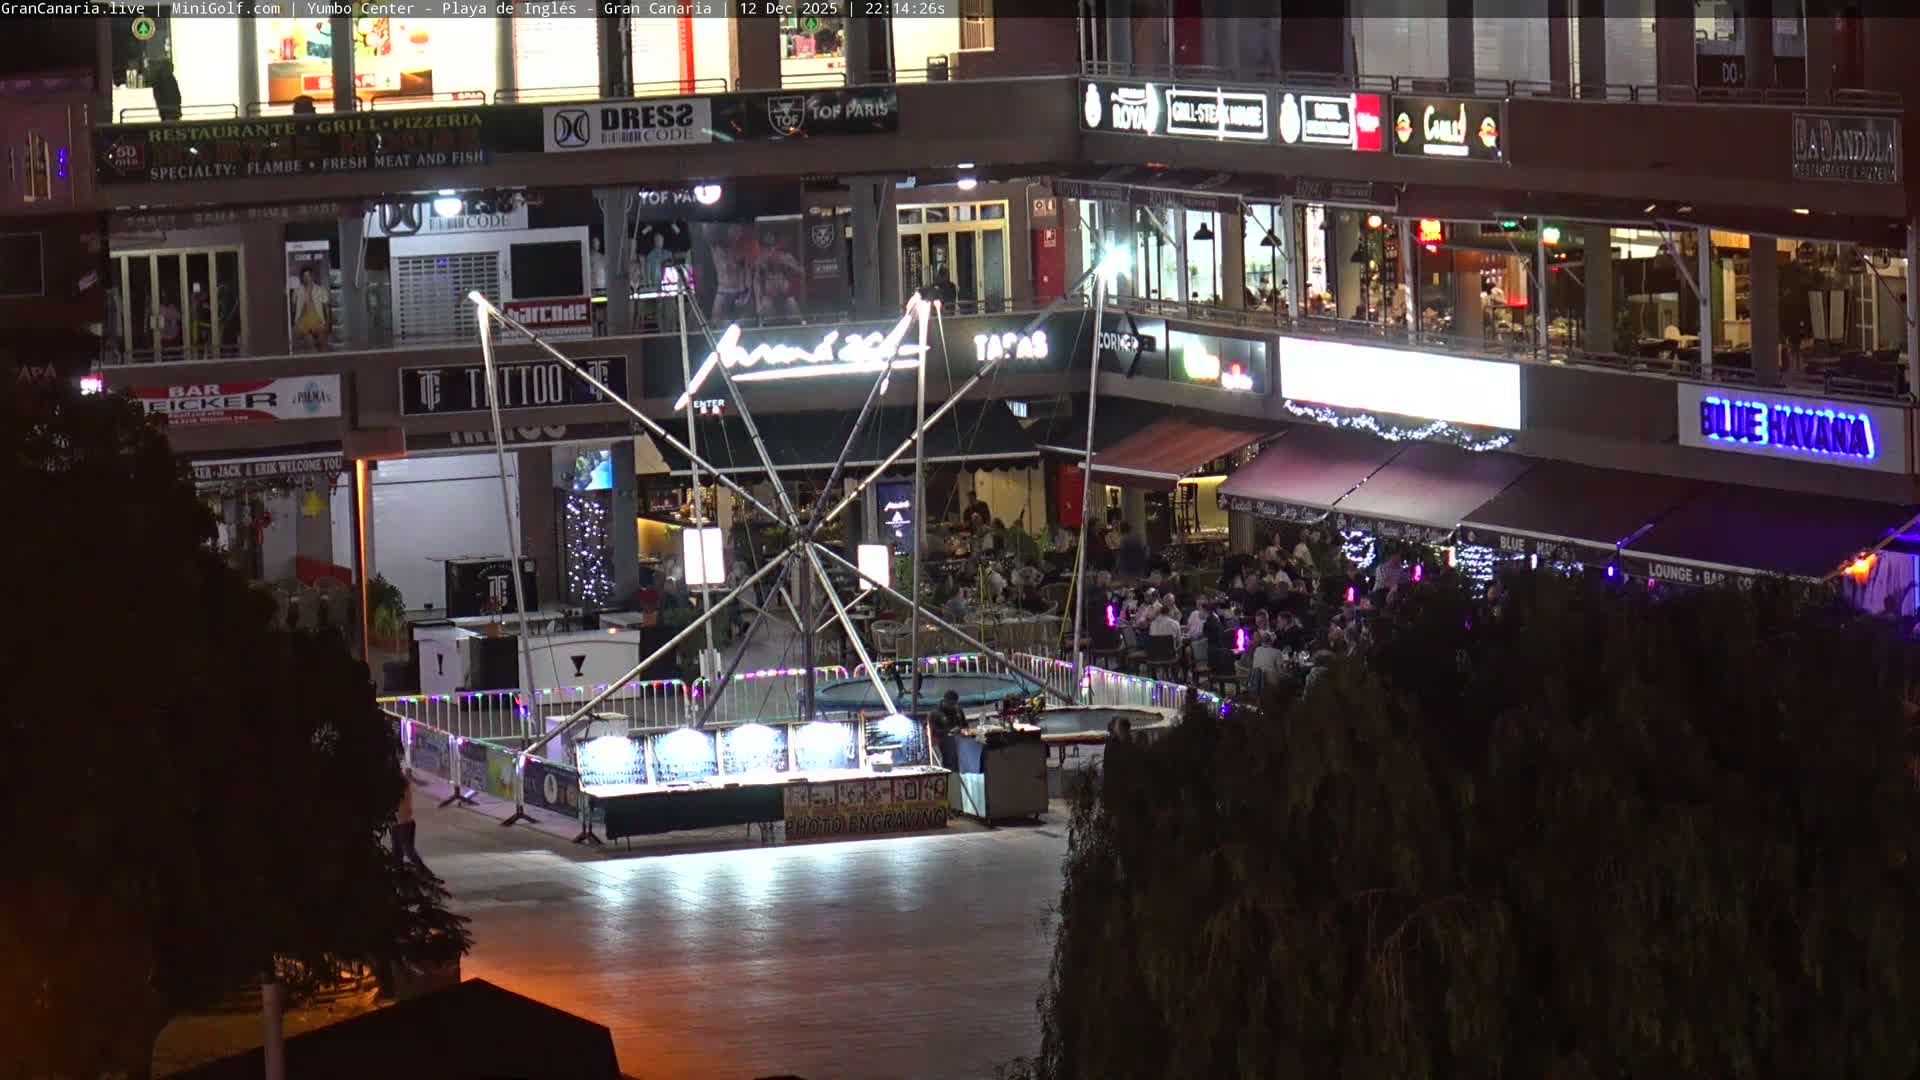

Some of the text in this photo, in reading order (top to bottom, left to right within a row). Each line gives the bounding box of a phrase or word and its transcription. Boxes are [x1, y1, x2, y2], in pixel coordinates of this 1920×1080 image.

[811, 101, 889, 120] TOF PARIS
[150, 112, 483, 143] RESTAURANTE GRILL PIZZERIA
[775, 115, 799, 127] TOF
[150, 164, 237, 181] SPECIALTY:
[247, 160, 301, 175] FLAMBE
[322, 156, 367, 169] FRESH
[375, 154, 410, 168] MEAT
[416, 152, 446, 165] AND
[452, 149, 484, 163] FISH
[169, 384, 220, 398] BAR
[693, 399, 725, 408] ENTER
[1701, 396, 1875, 459] BLUE HAVANA
[279, 459, 321, 474] WELCOME
[323, 455, 344, 471] YOU
[1500, 536, 1525, 551] BLUE
[1648, 562, 1692, 583] LOUNGE
[785, 807, 946, 836] PHOTO ENGRAVING
